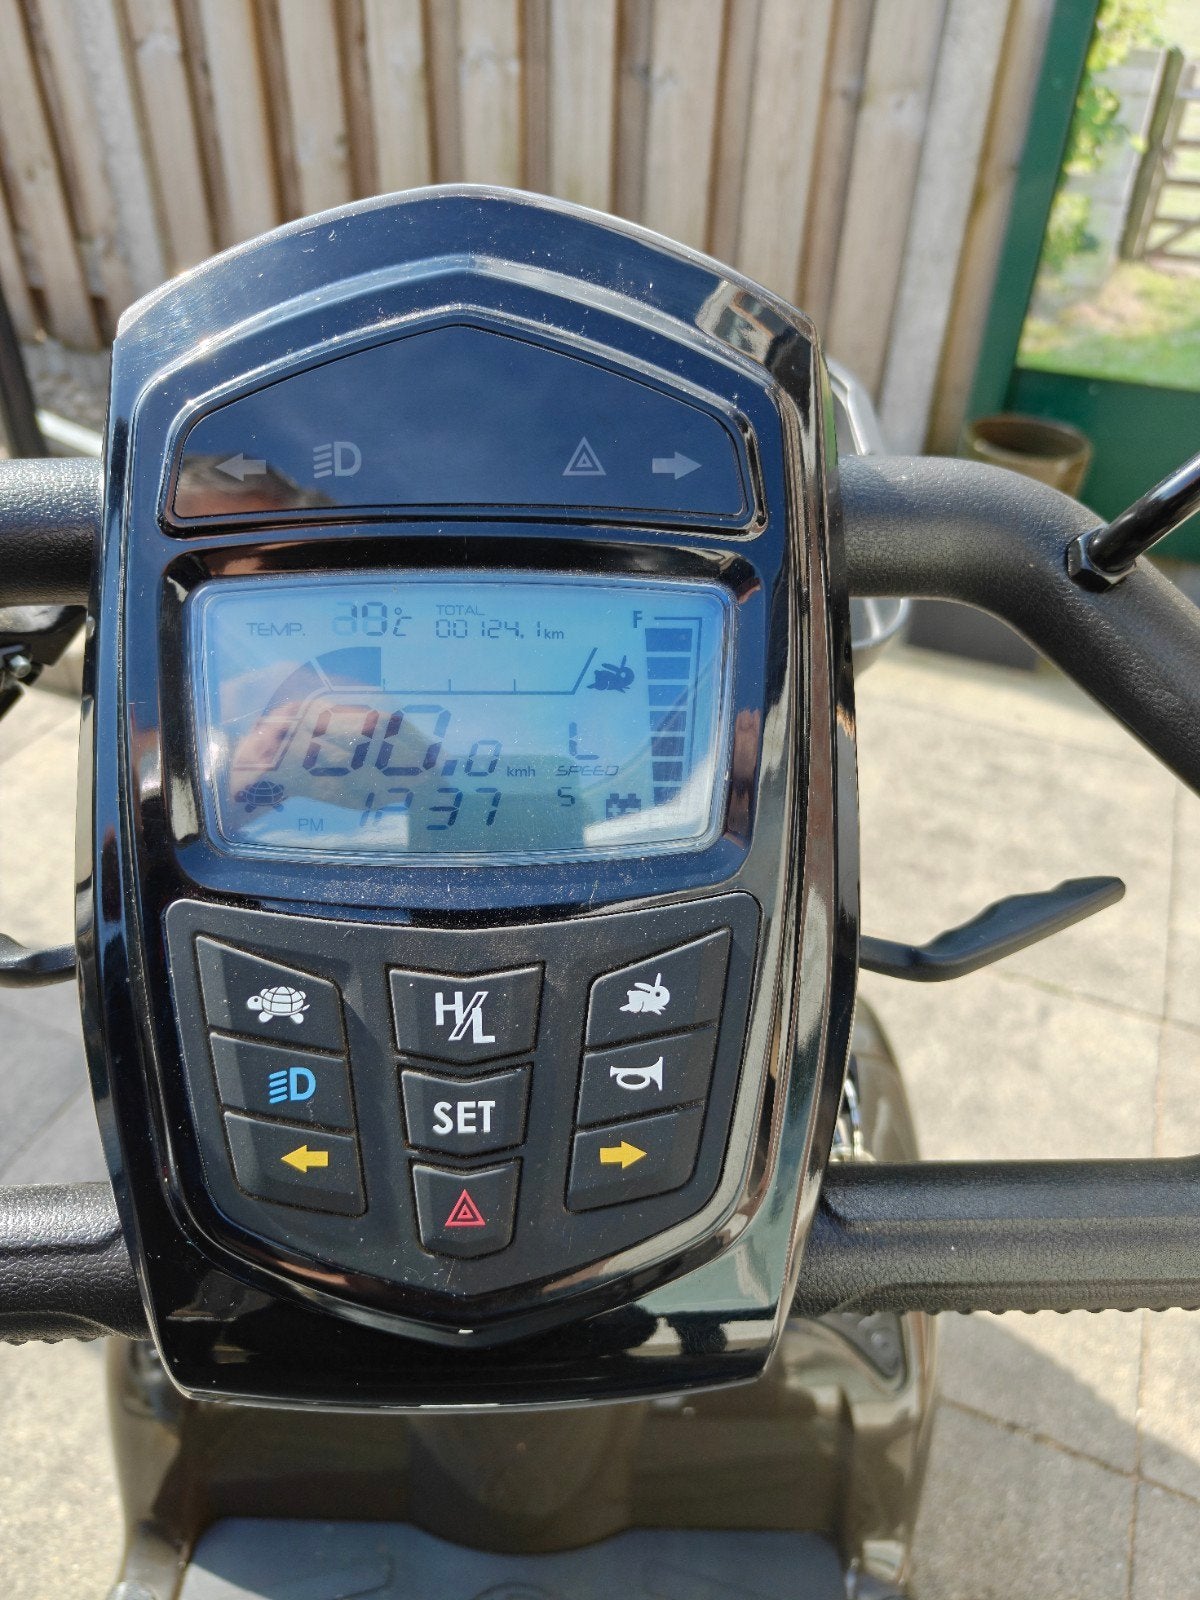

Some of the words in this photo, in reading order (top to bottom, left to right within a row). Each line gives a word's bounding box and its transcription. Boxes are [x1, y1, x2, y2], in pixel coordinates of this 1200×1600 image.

[435, 604, 485, 617] TOTAL
[632, 610, 643, 629] F
[246, 622, 306, 637] TEMP.
[506, 766, 536, 777] kmh
[554, 765, 620, 777] SPEED
[298, 817, 324, 831] PM
[432, 1100, 496, 1135] SET
